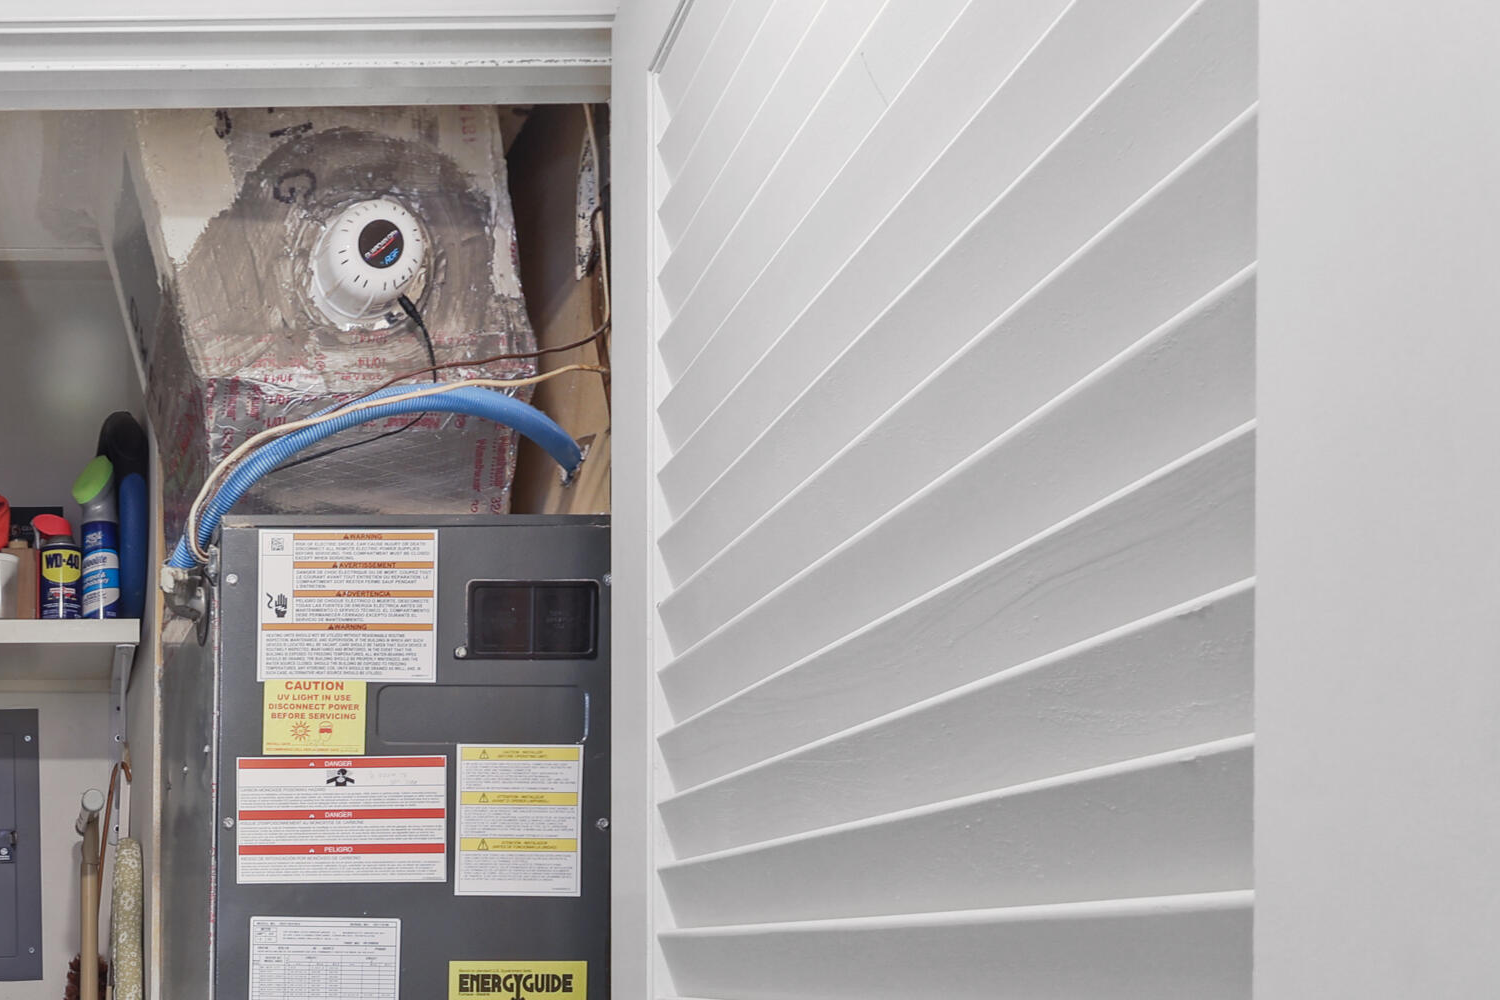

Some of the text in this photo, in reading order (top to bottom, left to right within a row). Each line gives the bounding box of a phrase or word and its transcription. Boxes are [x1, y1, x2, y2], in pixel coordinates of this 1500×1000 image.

[45, 553, 80, 569] WD-40
[285, 681, 344, 690] CAUTION
[459, 974, 573, 994] ENERGYGUIDE
